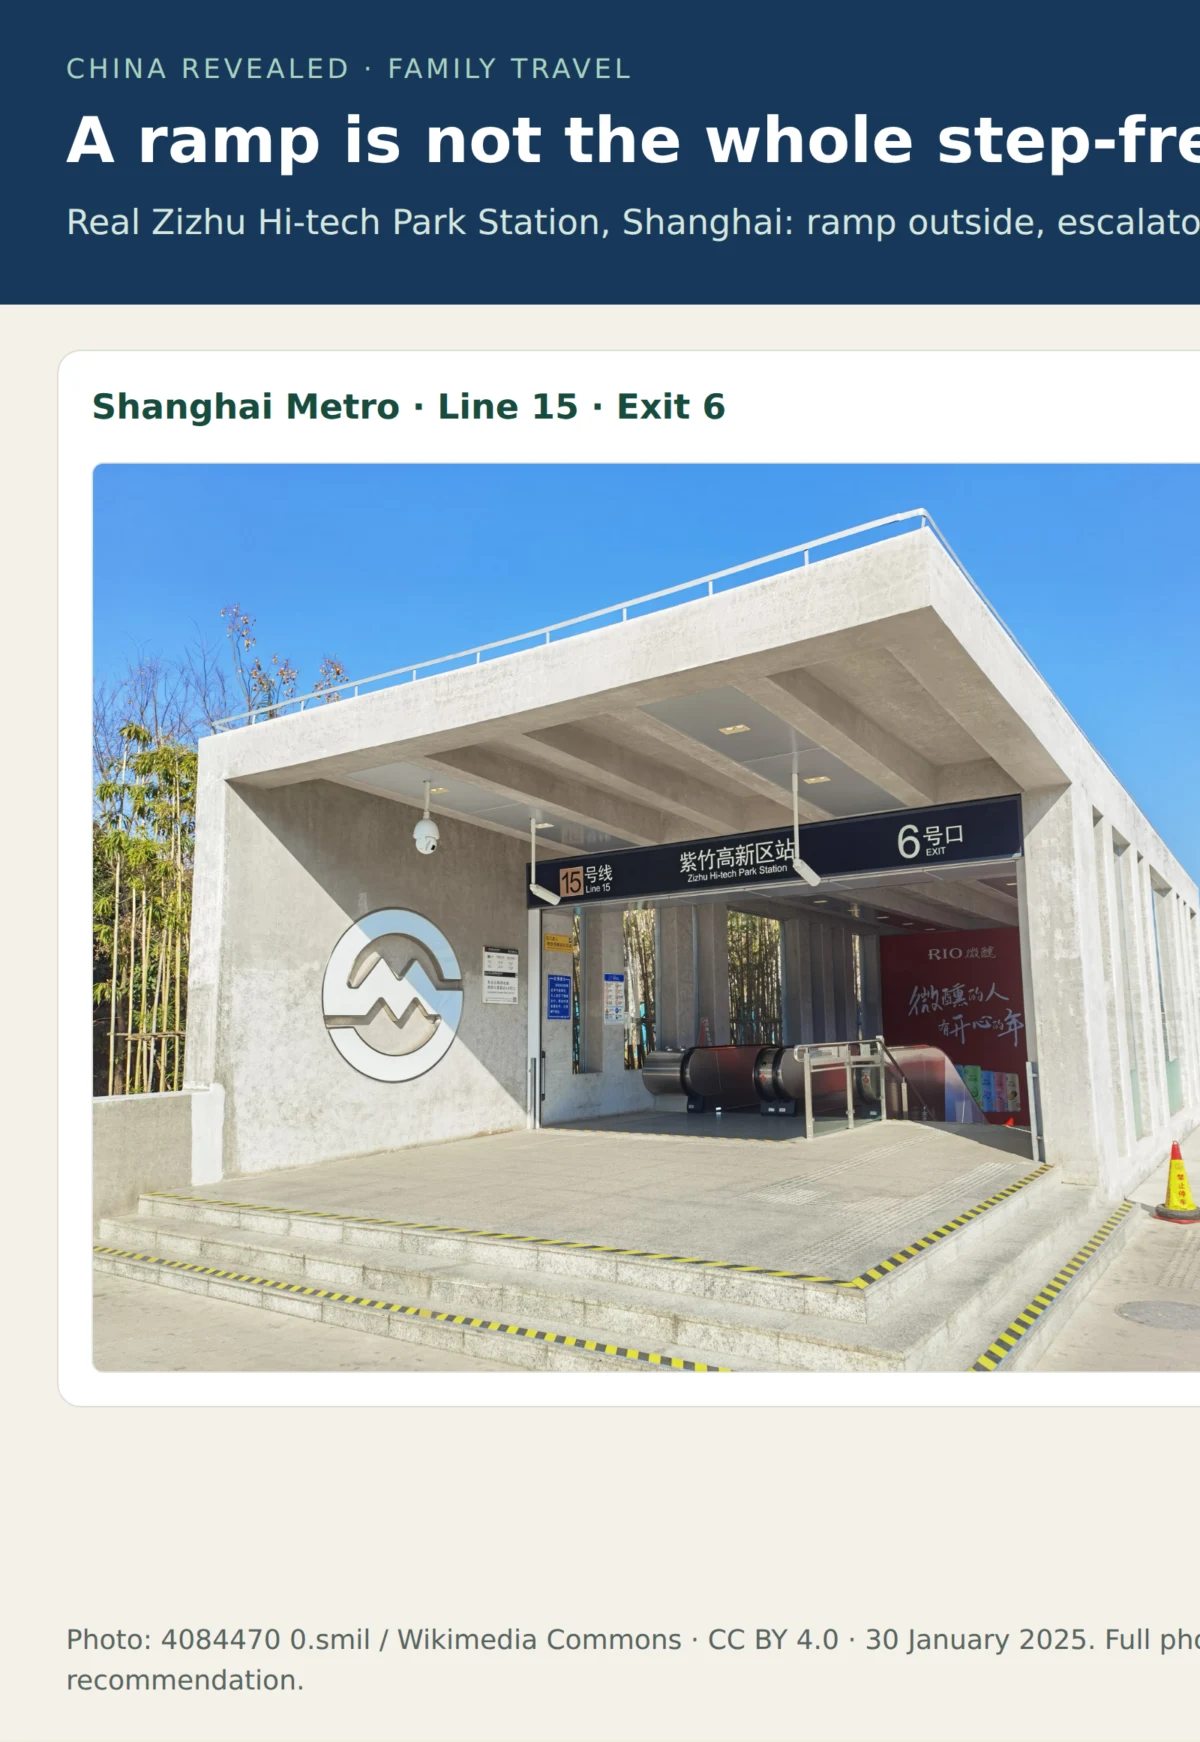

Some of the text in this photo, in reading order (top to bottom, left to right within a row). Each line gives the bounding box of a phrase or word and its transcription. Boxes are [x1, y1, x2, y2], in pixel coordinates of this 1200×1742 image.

[679, 837, 796, 874] 紫竹高新区站
[925, 846, 947, 857] EXIT
[687, 864, 788, 883] Zizhu Hi-tech Park Station
[585, 882, 611, 894] Line 15
[928, 947, 963, 960] RIO
